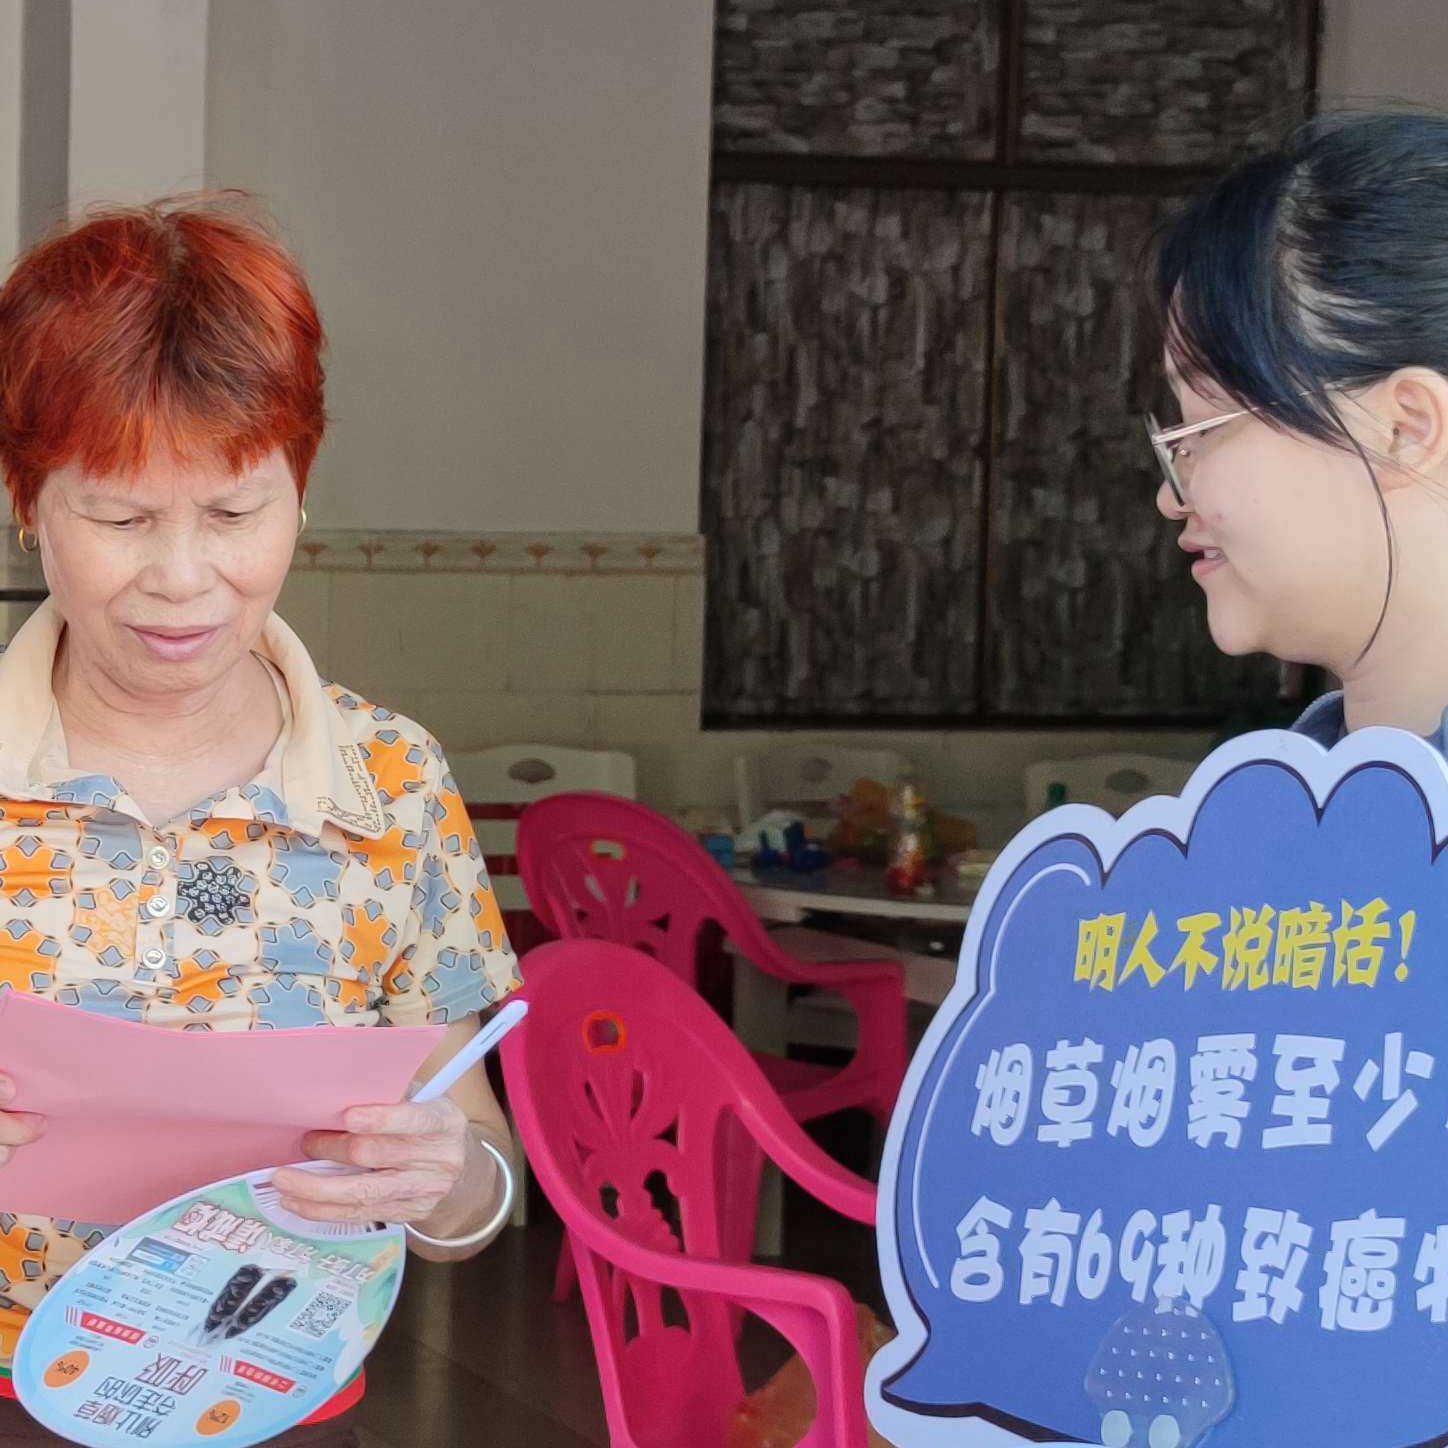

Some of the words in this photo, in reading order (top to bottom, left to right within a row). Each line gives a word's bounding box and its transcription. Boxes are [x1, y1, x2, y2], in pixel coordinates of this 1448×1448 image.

[1073, 897, 1417, 993] 明人不说暗话!
[134, 1352, 209, 1397] 呼吸
